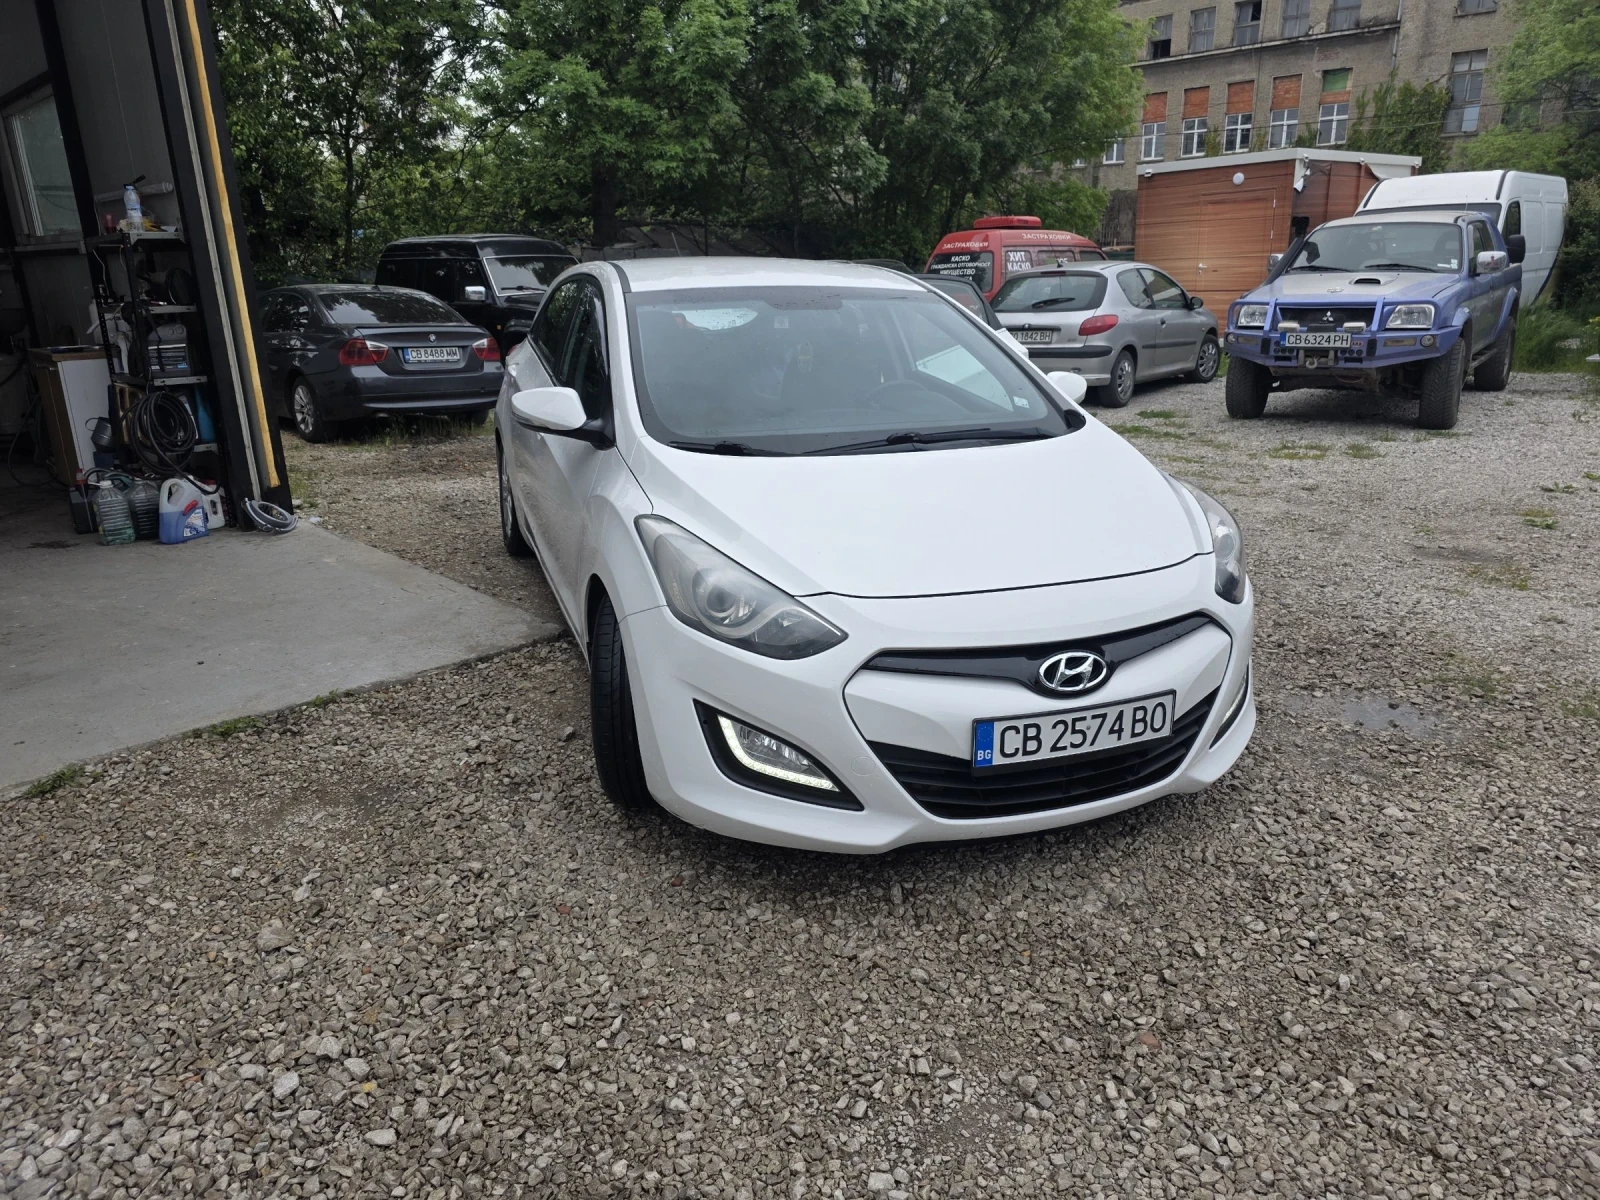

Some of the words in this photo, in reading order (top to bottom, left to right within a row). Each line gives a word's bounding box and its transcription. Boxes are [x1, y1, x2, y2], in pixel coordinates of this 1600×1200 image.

[950, 254, 971, 263] КАСКО
[1008, 251, 1025, 262] ХИТ
[1007, 262, 1031, 271] КАСКО
[939, 268, 976, 276] ИМУЩЕСТВО
[1020, 331, 1039, 341] 1842
[1039, 331, 1051, 341] BH
[1287, 334, 1302, 345] CB
[1303, 334, 1332, 346] 6324
[1333, 335, 1349, 346] PH
[410, 349, 423, 359] CB
[423, 349, 446, 359] 8488
[1000, 722, 1043, 759] CB
[1050, 709, 1124, 753] 2574
[1130, 701, 1167, 739] BO
[977, 749, 992, 761] BG
